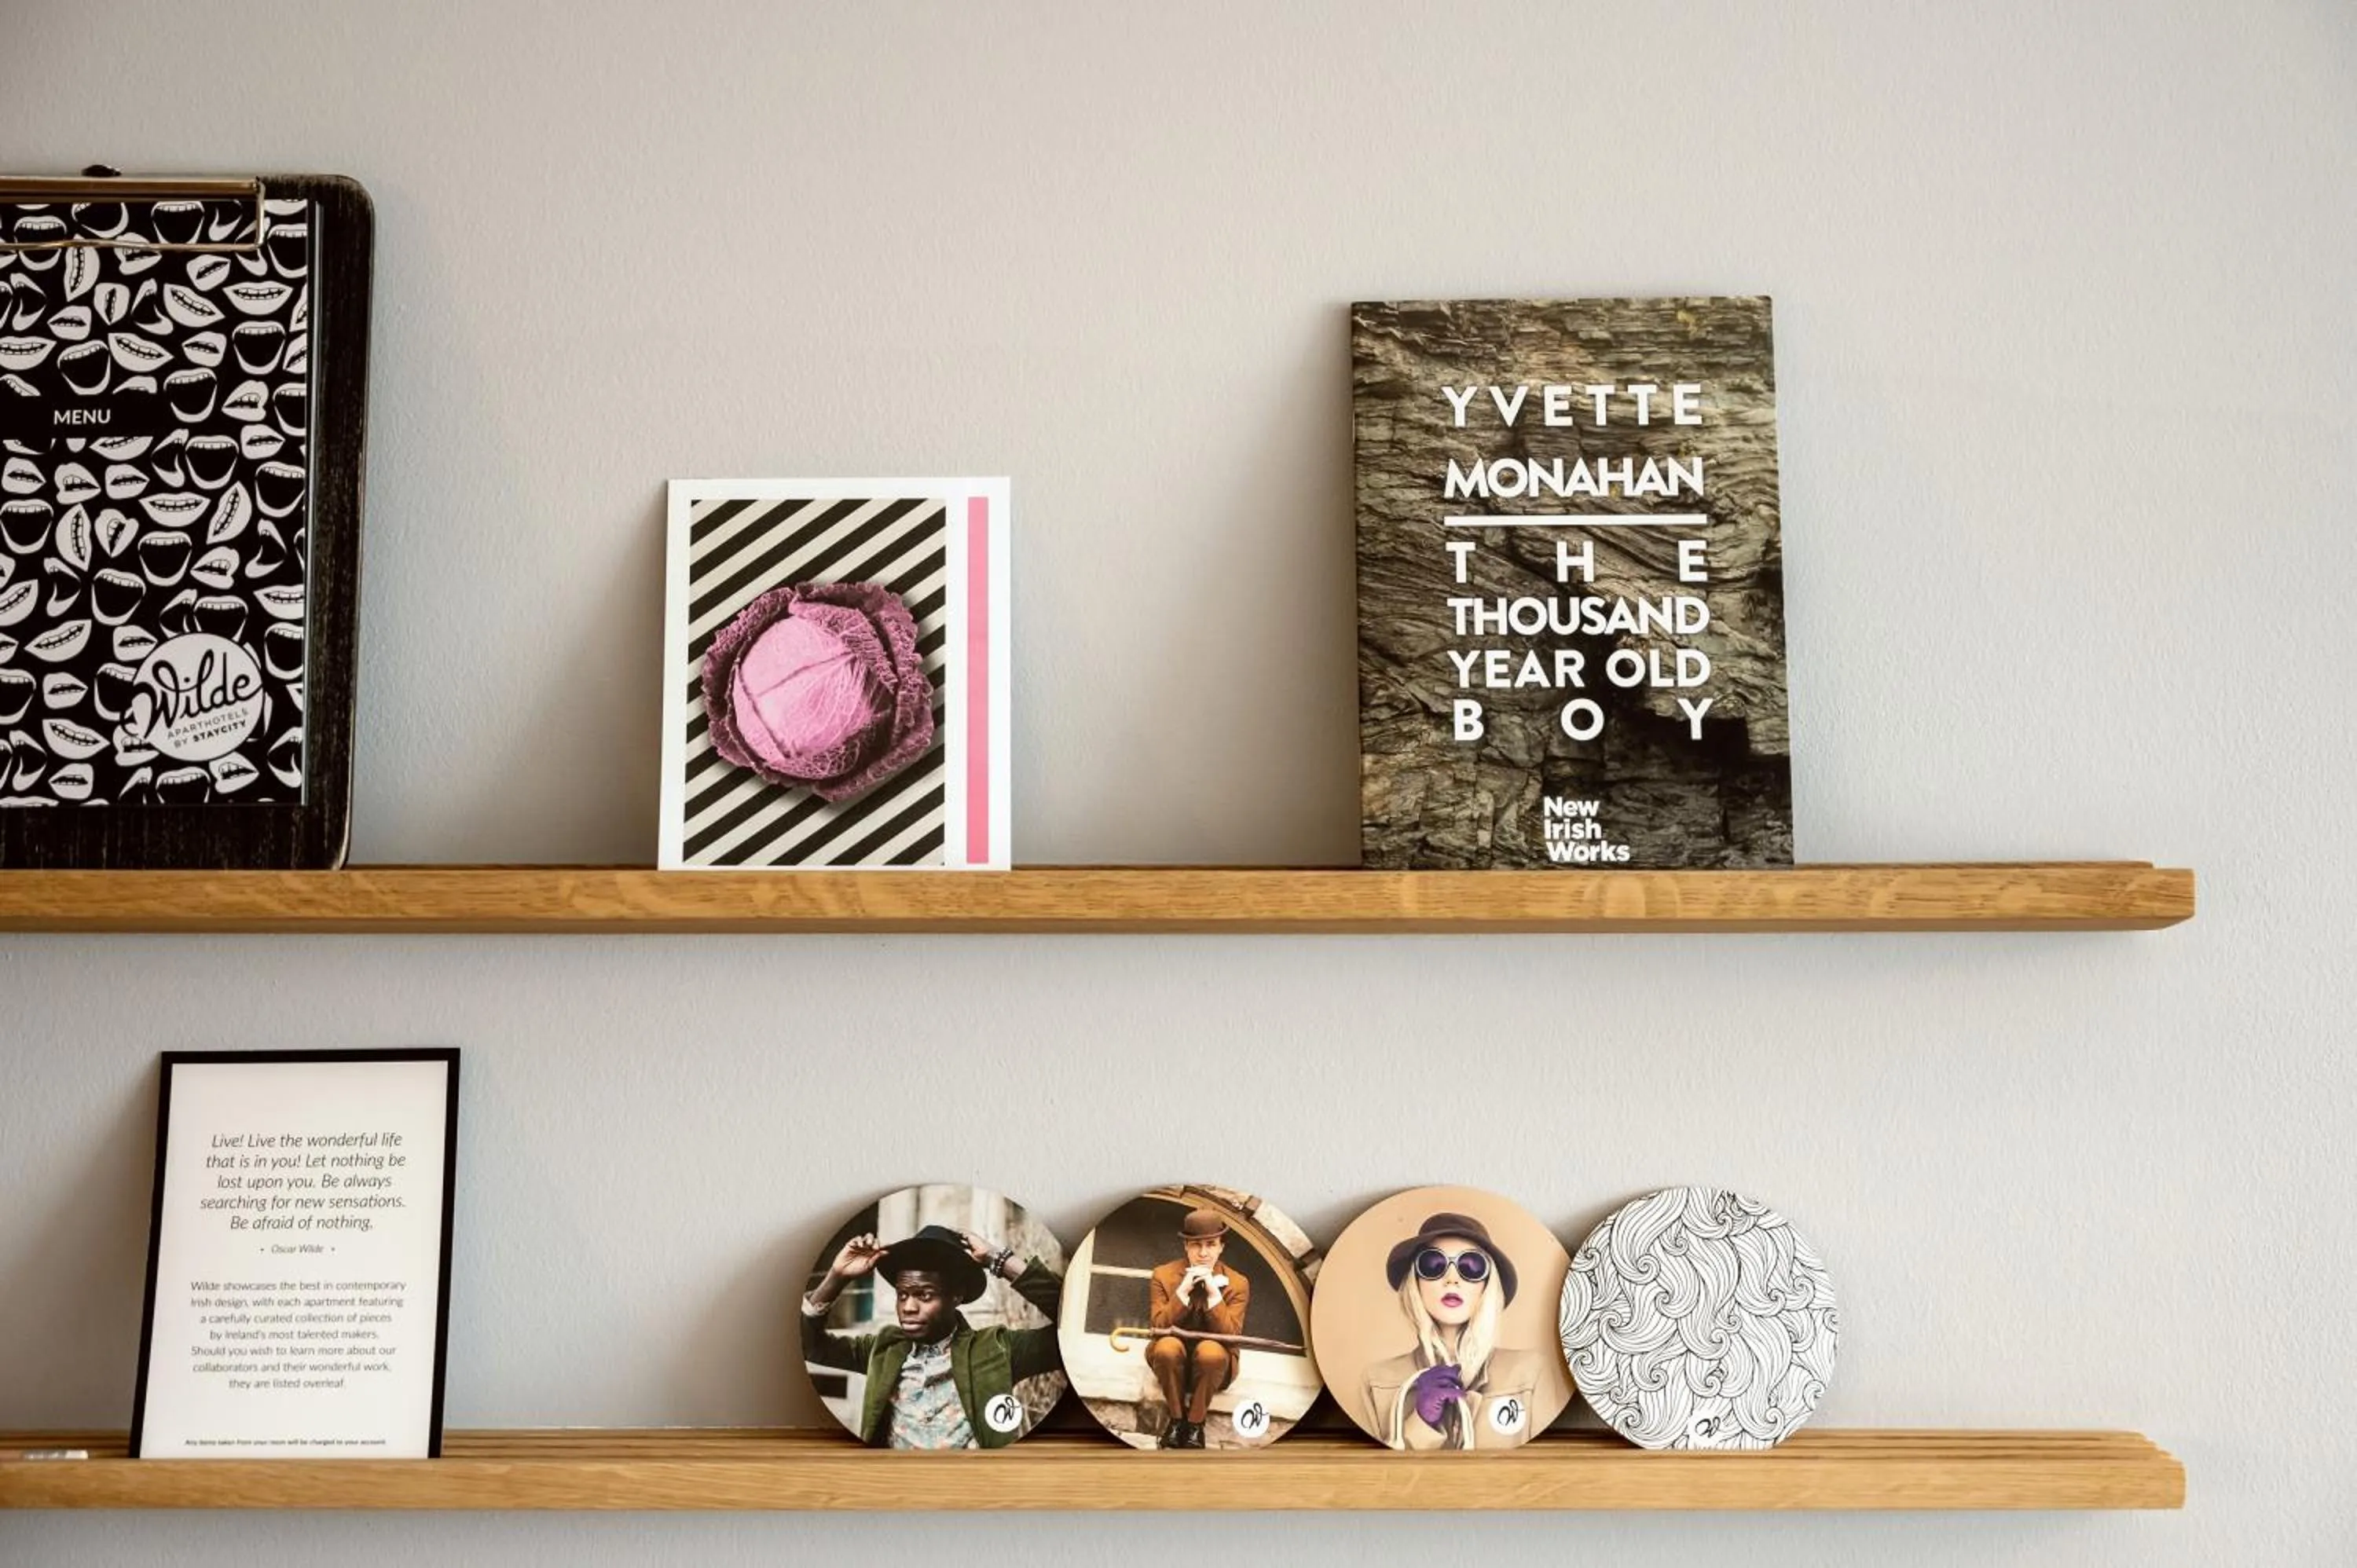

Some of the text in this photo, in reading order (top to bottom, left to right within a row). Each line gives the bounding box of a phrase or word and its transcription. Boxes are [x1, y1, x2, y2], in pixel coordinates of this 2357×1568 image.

[1442, 383, 1703, 427] YVETTE
[53, 408, 111, 424] MENU
[1443, 456, 1704, 498] MONAHAN
[1446, 540, 1708, 584] THE
[1446, 597, 1710, 636] THOUSAND
[1447, 650, 1711, 688] YEAR OLD
[122, 649, 262, 738] Wilde
[167, 708, 248, 739] APARTHOTELS
[1453, 698, 1715, 742] BOY
[174, 720, 247, 748] BY STAYCITY
[1543, 796, 1600, 818] New
[1544, 819, 1602, 840] Irish
[1546, 841, 1630, 863] Works
[211, 1132, 402, 1149] Live! Live the wonderful life
[206, 1152, 406, 1170] that is in you! Let nothing be
[218, 1174, 392, 1190] lost upon you. Be always
[200, 1195, 406, 1211] searching for new sensations.
[230, 1215, 372, 1232] Be afraid of nothing.
[271, 1244, 324, 1254] Oscar Wilde
[191, 1281, 406, 1291] Wilde showcases the best in contemporary
[191, 1297, 404, 1309] Irish design, with each apartment featuring
[200, 1313, 392, 1324] a carefully curated collection of pieces
[210, 1331, 222, 1340] by
[268, 1331, 294, 1339] most
[298, 1330, 339, 1339] talented
[191, 1346, 225, 1356] Should
[228, 1348, 247, 1357] you
[250, 1346, 273, 1355] wish
[276, 1346, 287, 1355] to
[290, 1346, 314, 1355] learn
[346, 1346, 376, 1355] about
[379, 1346, 396, 1355] our
[192, 1363, 258, 1372] collaborators
[261, 1362, 280, 1372] and
[283, 1362, 306, 1372] their
[310, 1361, 361, 1372] wonderful
[229, 1379, 251, 1390] they
[254, 1380, 270, 1389] are
[273, 1379, 300, 1389] listed
